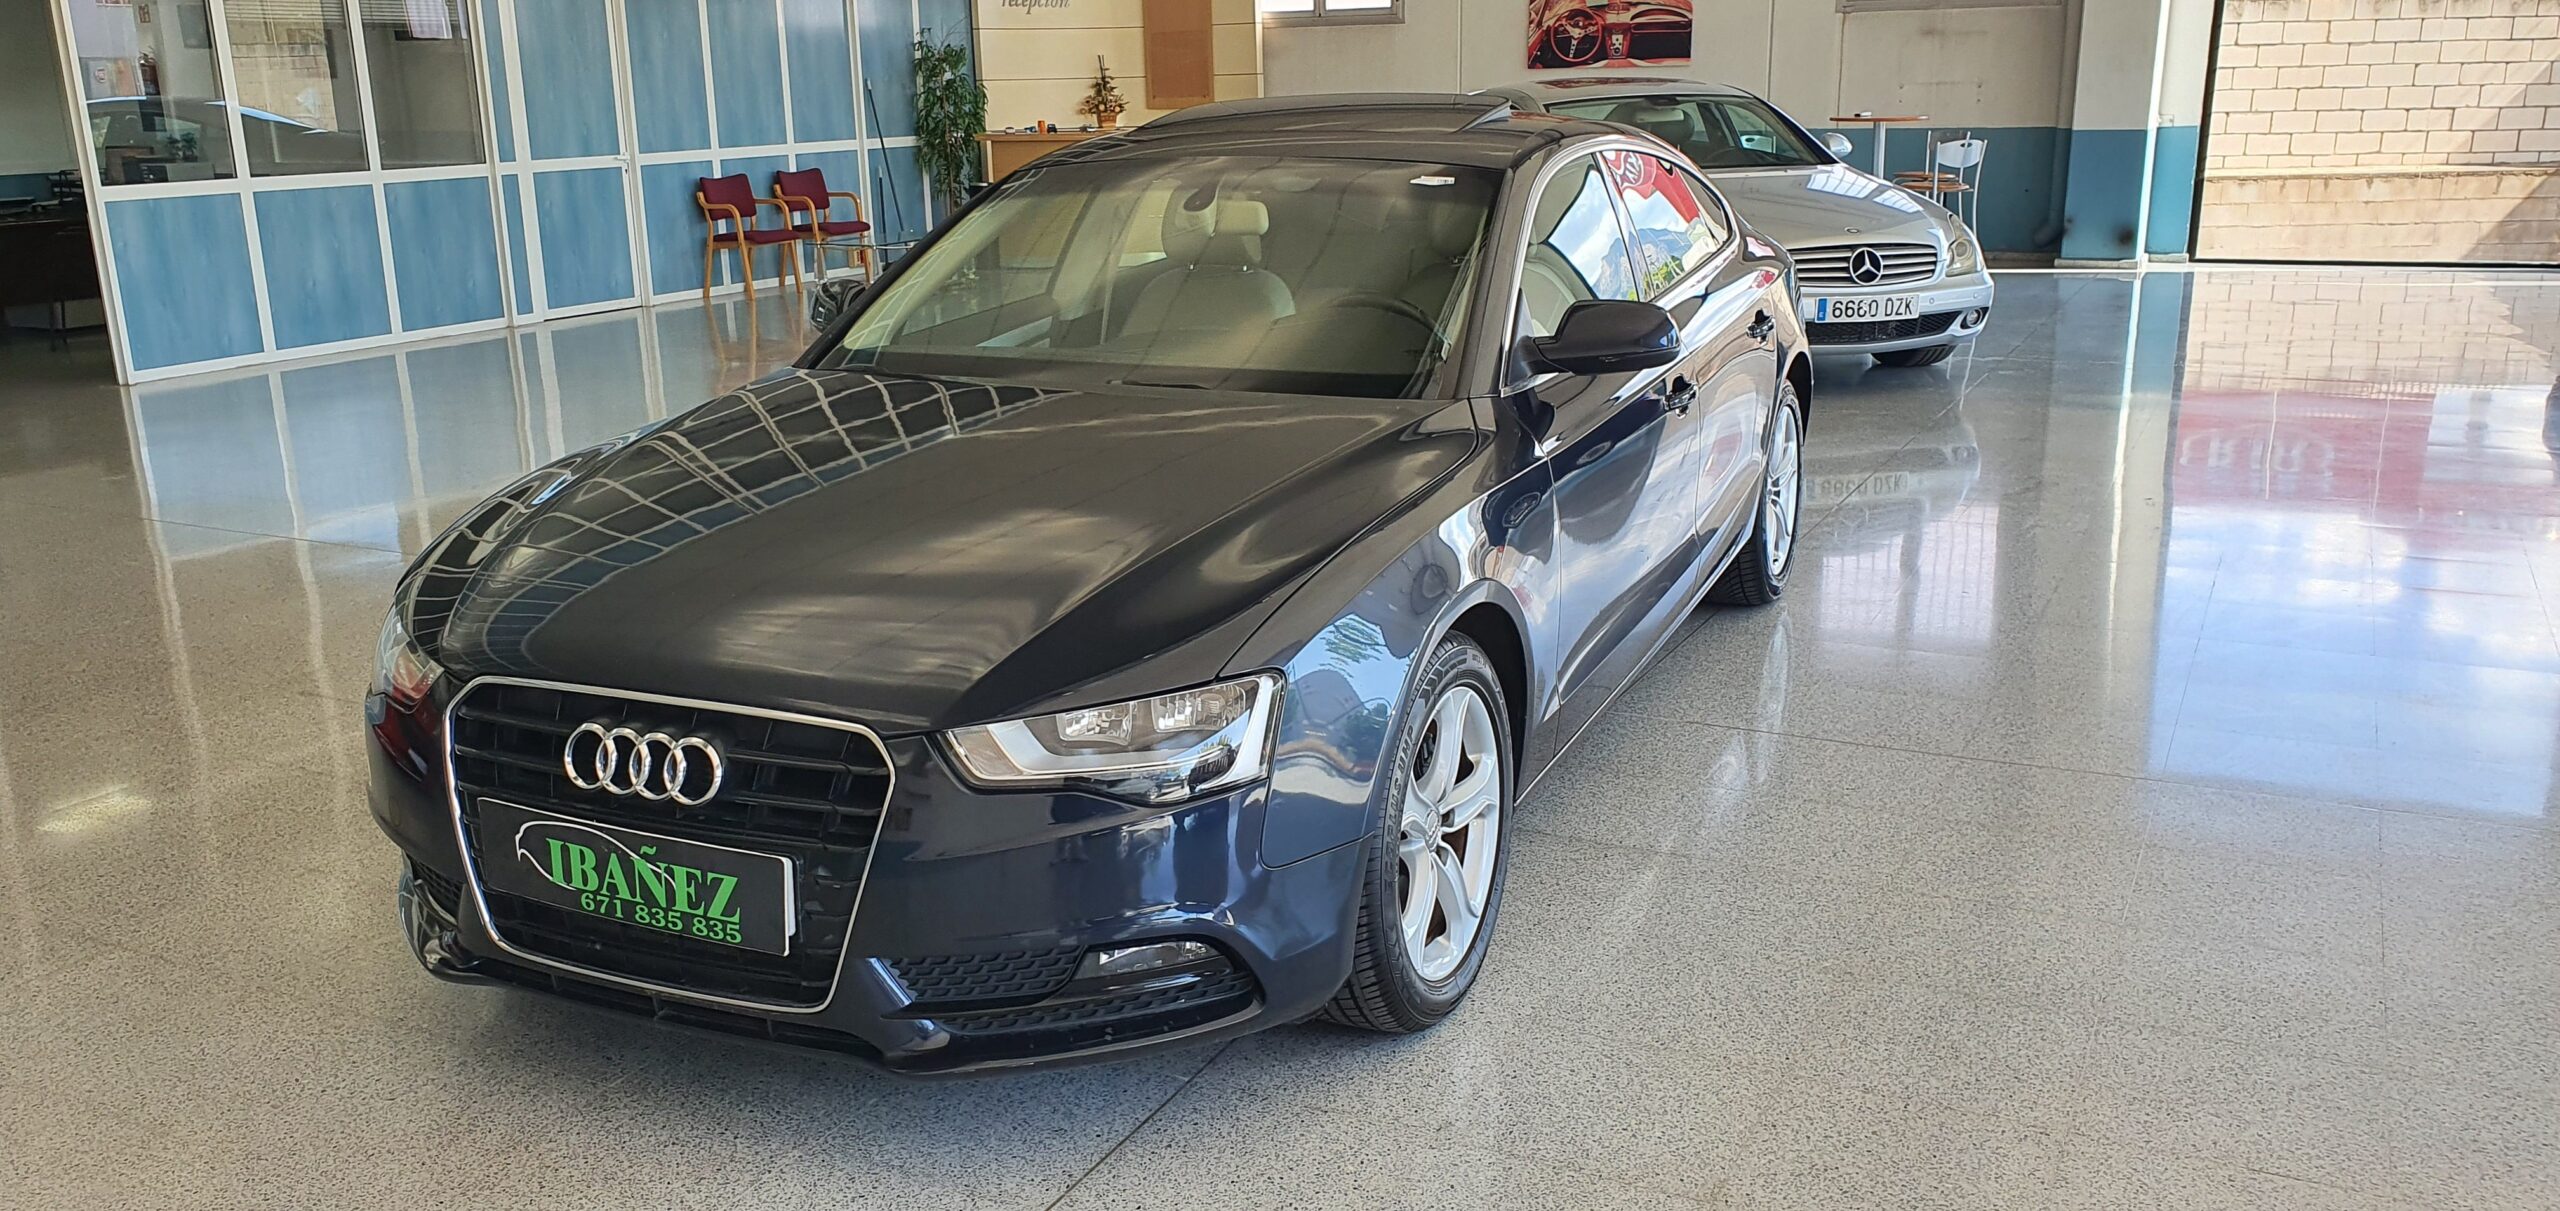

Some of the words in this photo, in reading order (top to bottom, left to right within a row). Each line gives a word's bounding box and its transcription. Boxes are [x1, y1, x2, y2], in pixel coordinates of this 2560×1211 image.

[1884, 297, 1913, 317] DZK
[546, 838, 741, 923] IBAÑEZ
[581, 892, 624, 918] 671
[635, 904, 683, 931] 835
[692, 918, 742, 944] 835
